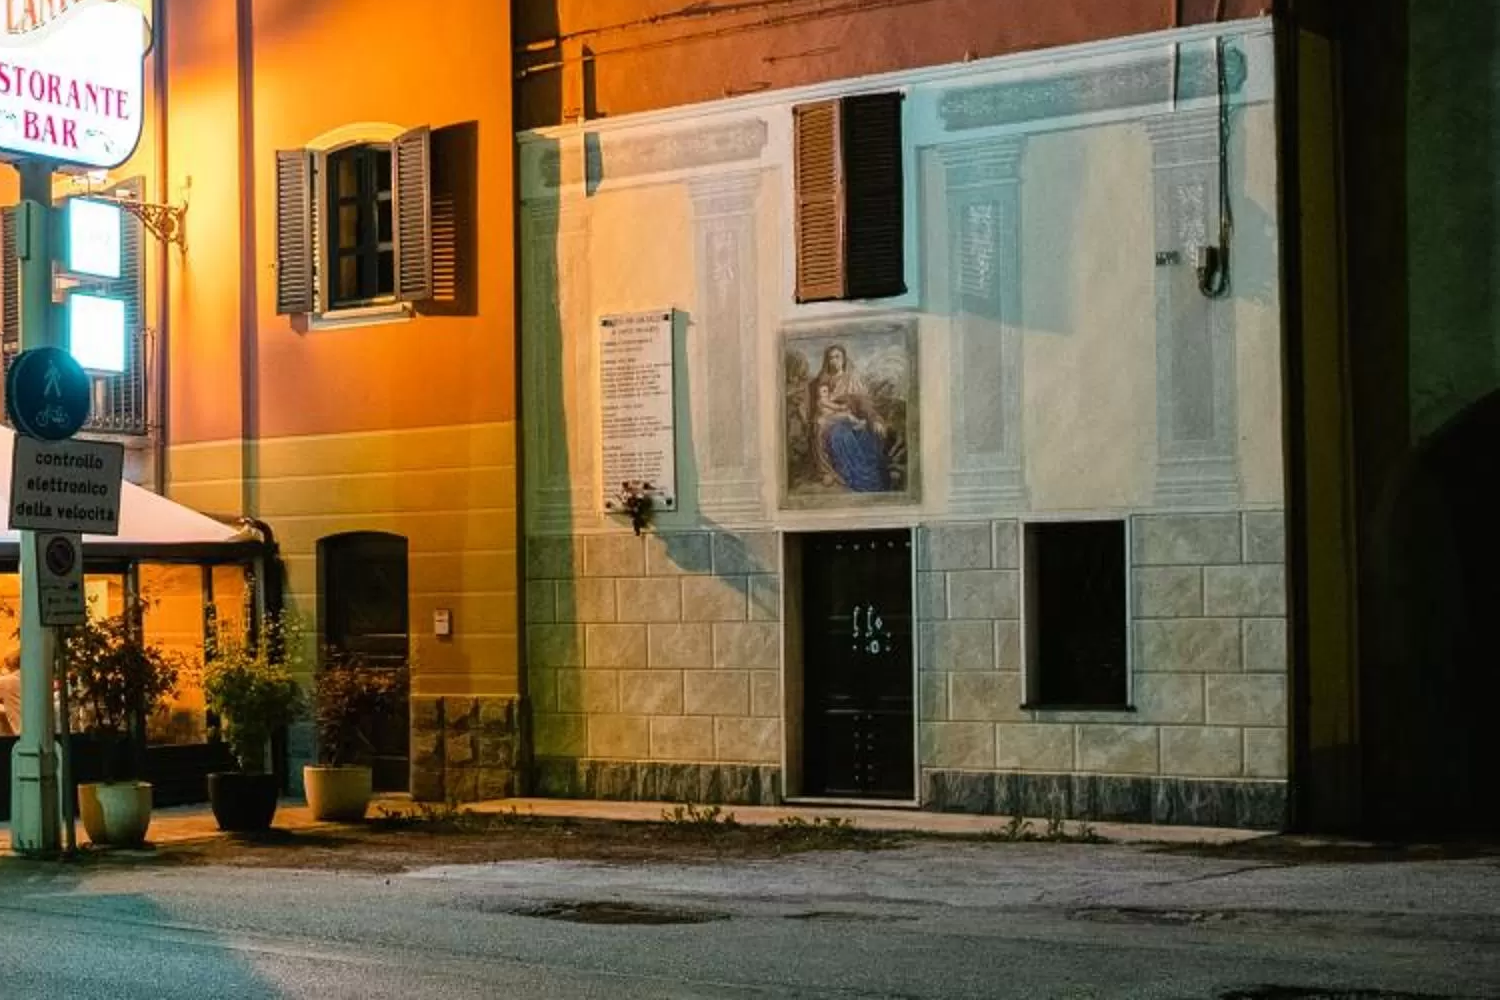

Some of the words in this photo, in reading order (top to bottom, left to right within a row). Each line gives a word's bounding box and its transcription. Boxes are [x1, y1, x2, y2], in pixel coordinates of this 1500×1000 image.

[22, 109, 79, 149] BAR
[35, 452, 104, 469] controllo
[27, 475, 108, 497] elettronico
[16, 501, 52, 518] della
